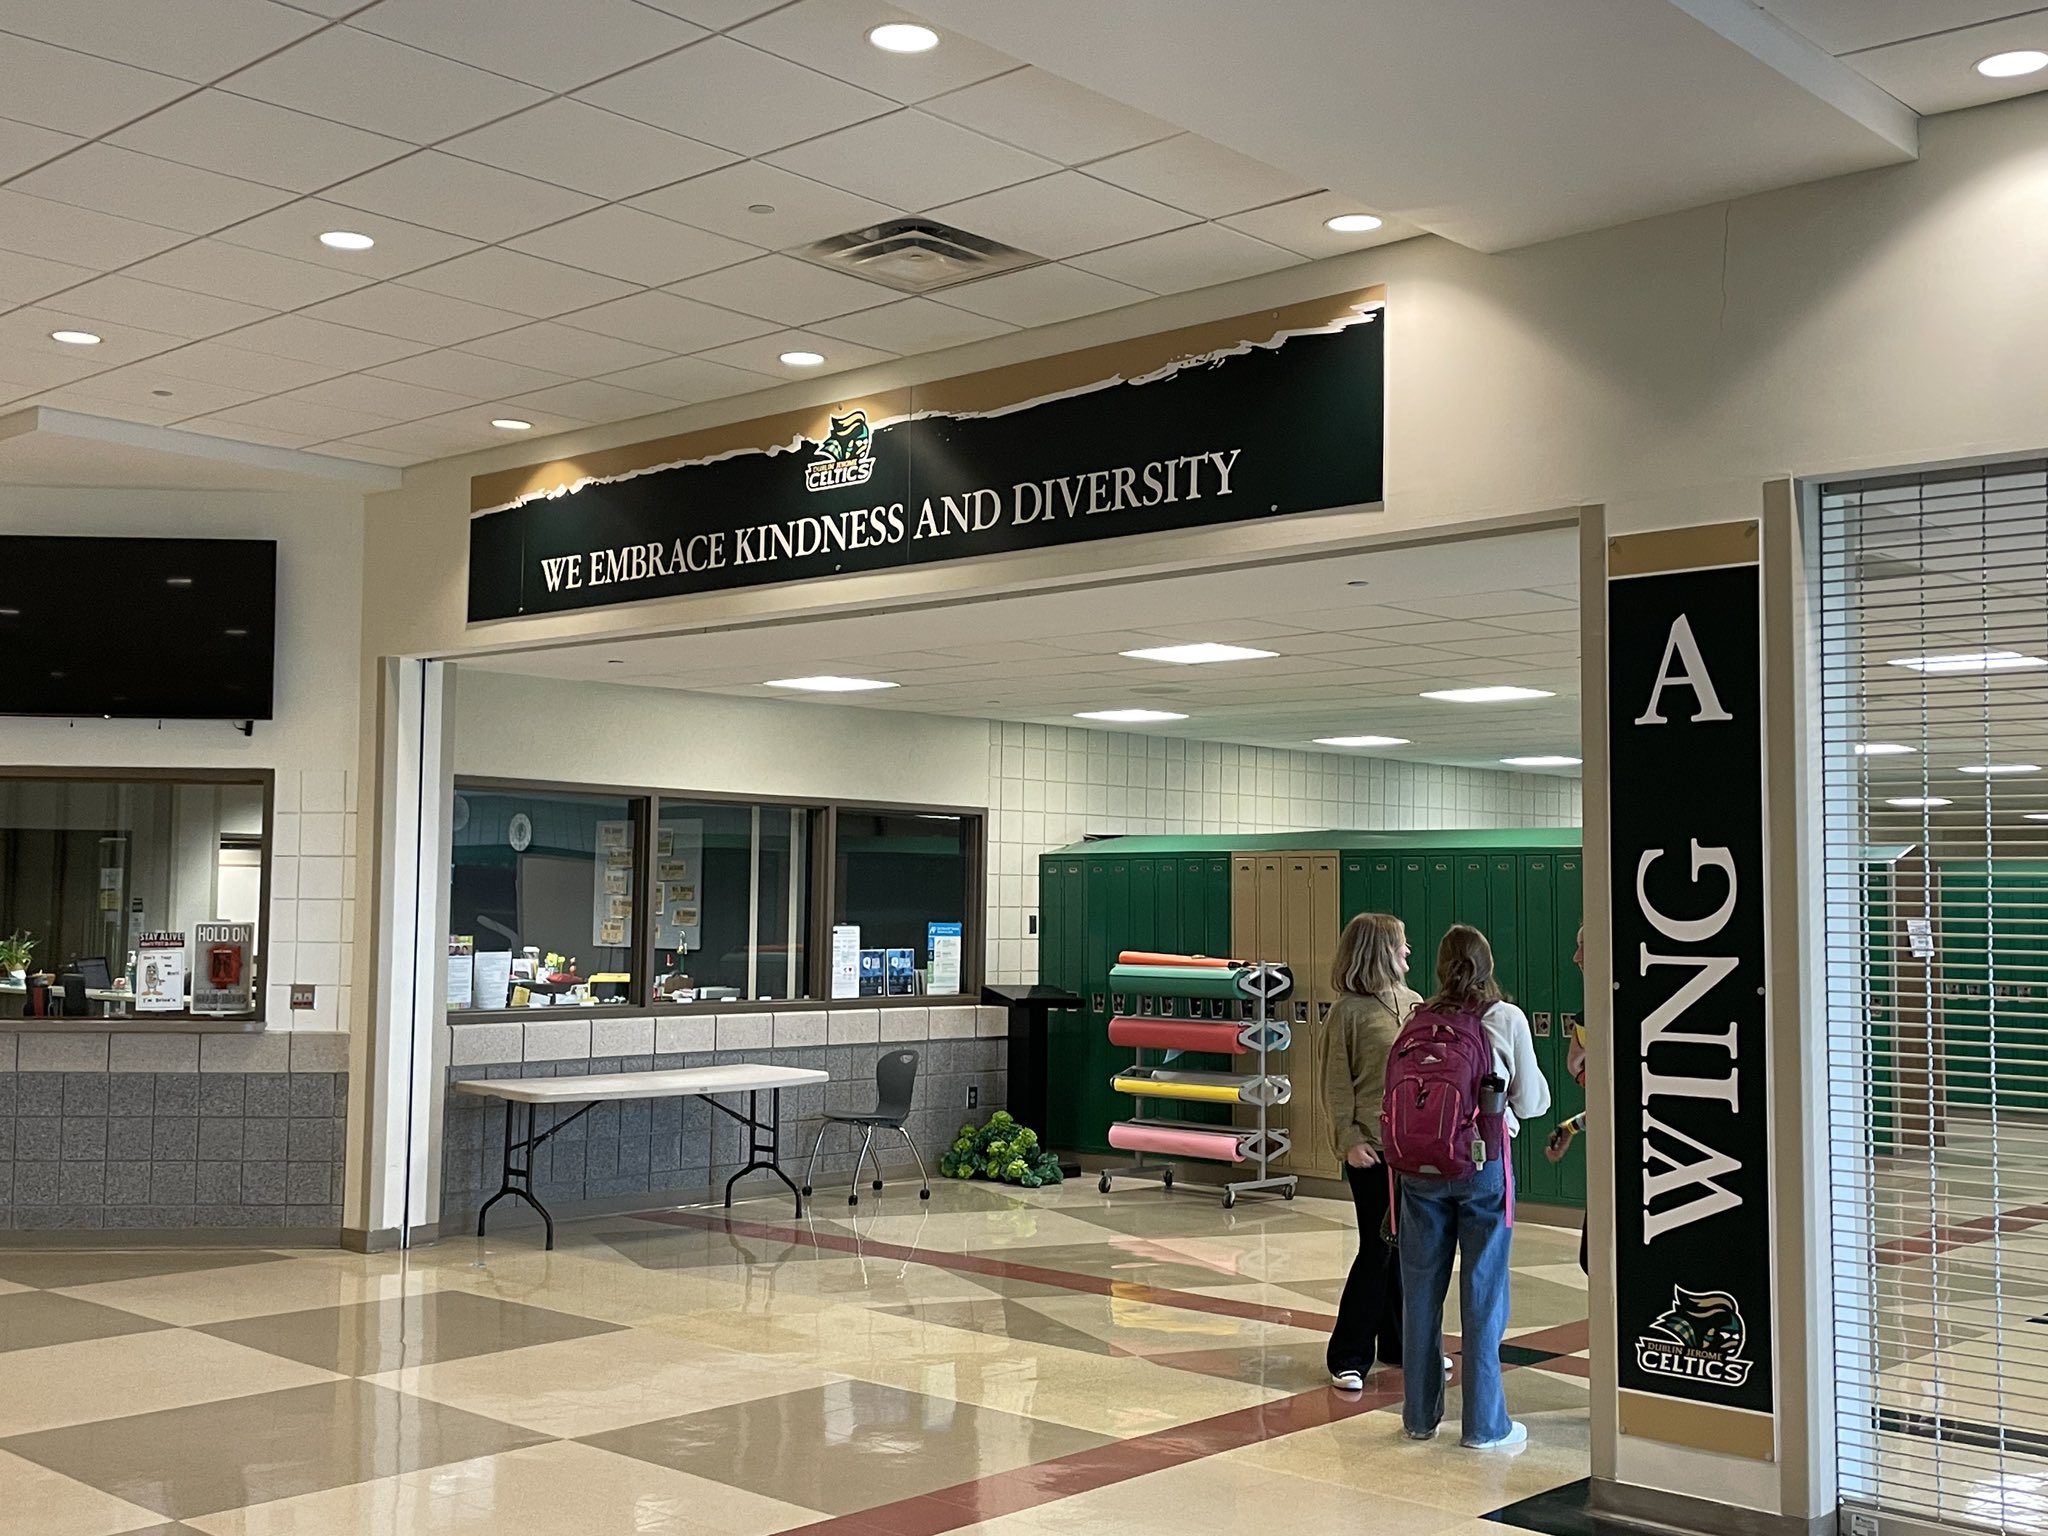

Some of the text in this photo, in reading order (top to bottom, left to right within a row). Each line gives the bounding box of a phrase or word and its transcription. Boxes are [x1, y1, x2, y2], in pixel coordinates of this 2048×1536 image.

[809, 463, 869, 488] CELTICS
[541, 449, 1241, 592] WE EMBRACE KINDNESS AND DIVERSITY
[140, 932, 159, 941] STAY
[198, 926, 250, 942] HOLD ON
[1635, 614, 1742, 1245] WING A
[1647, 1342, 1723, 1361] DUBLIN JEROME
[1642, 1351, 1743, 1381] CELTICS
